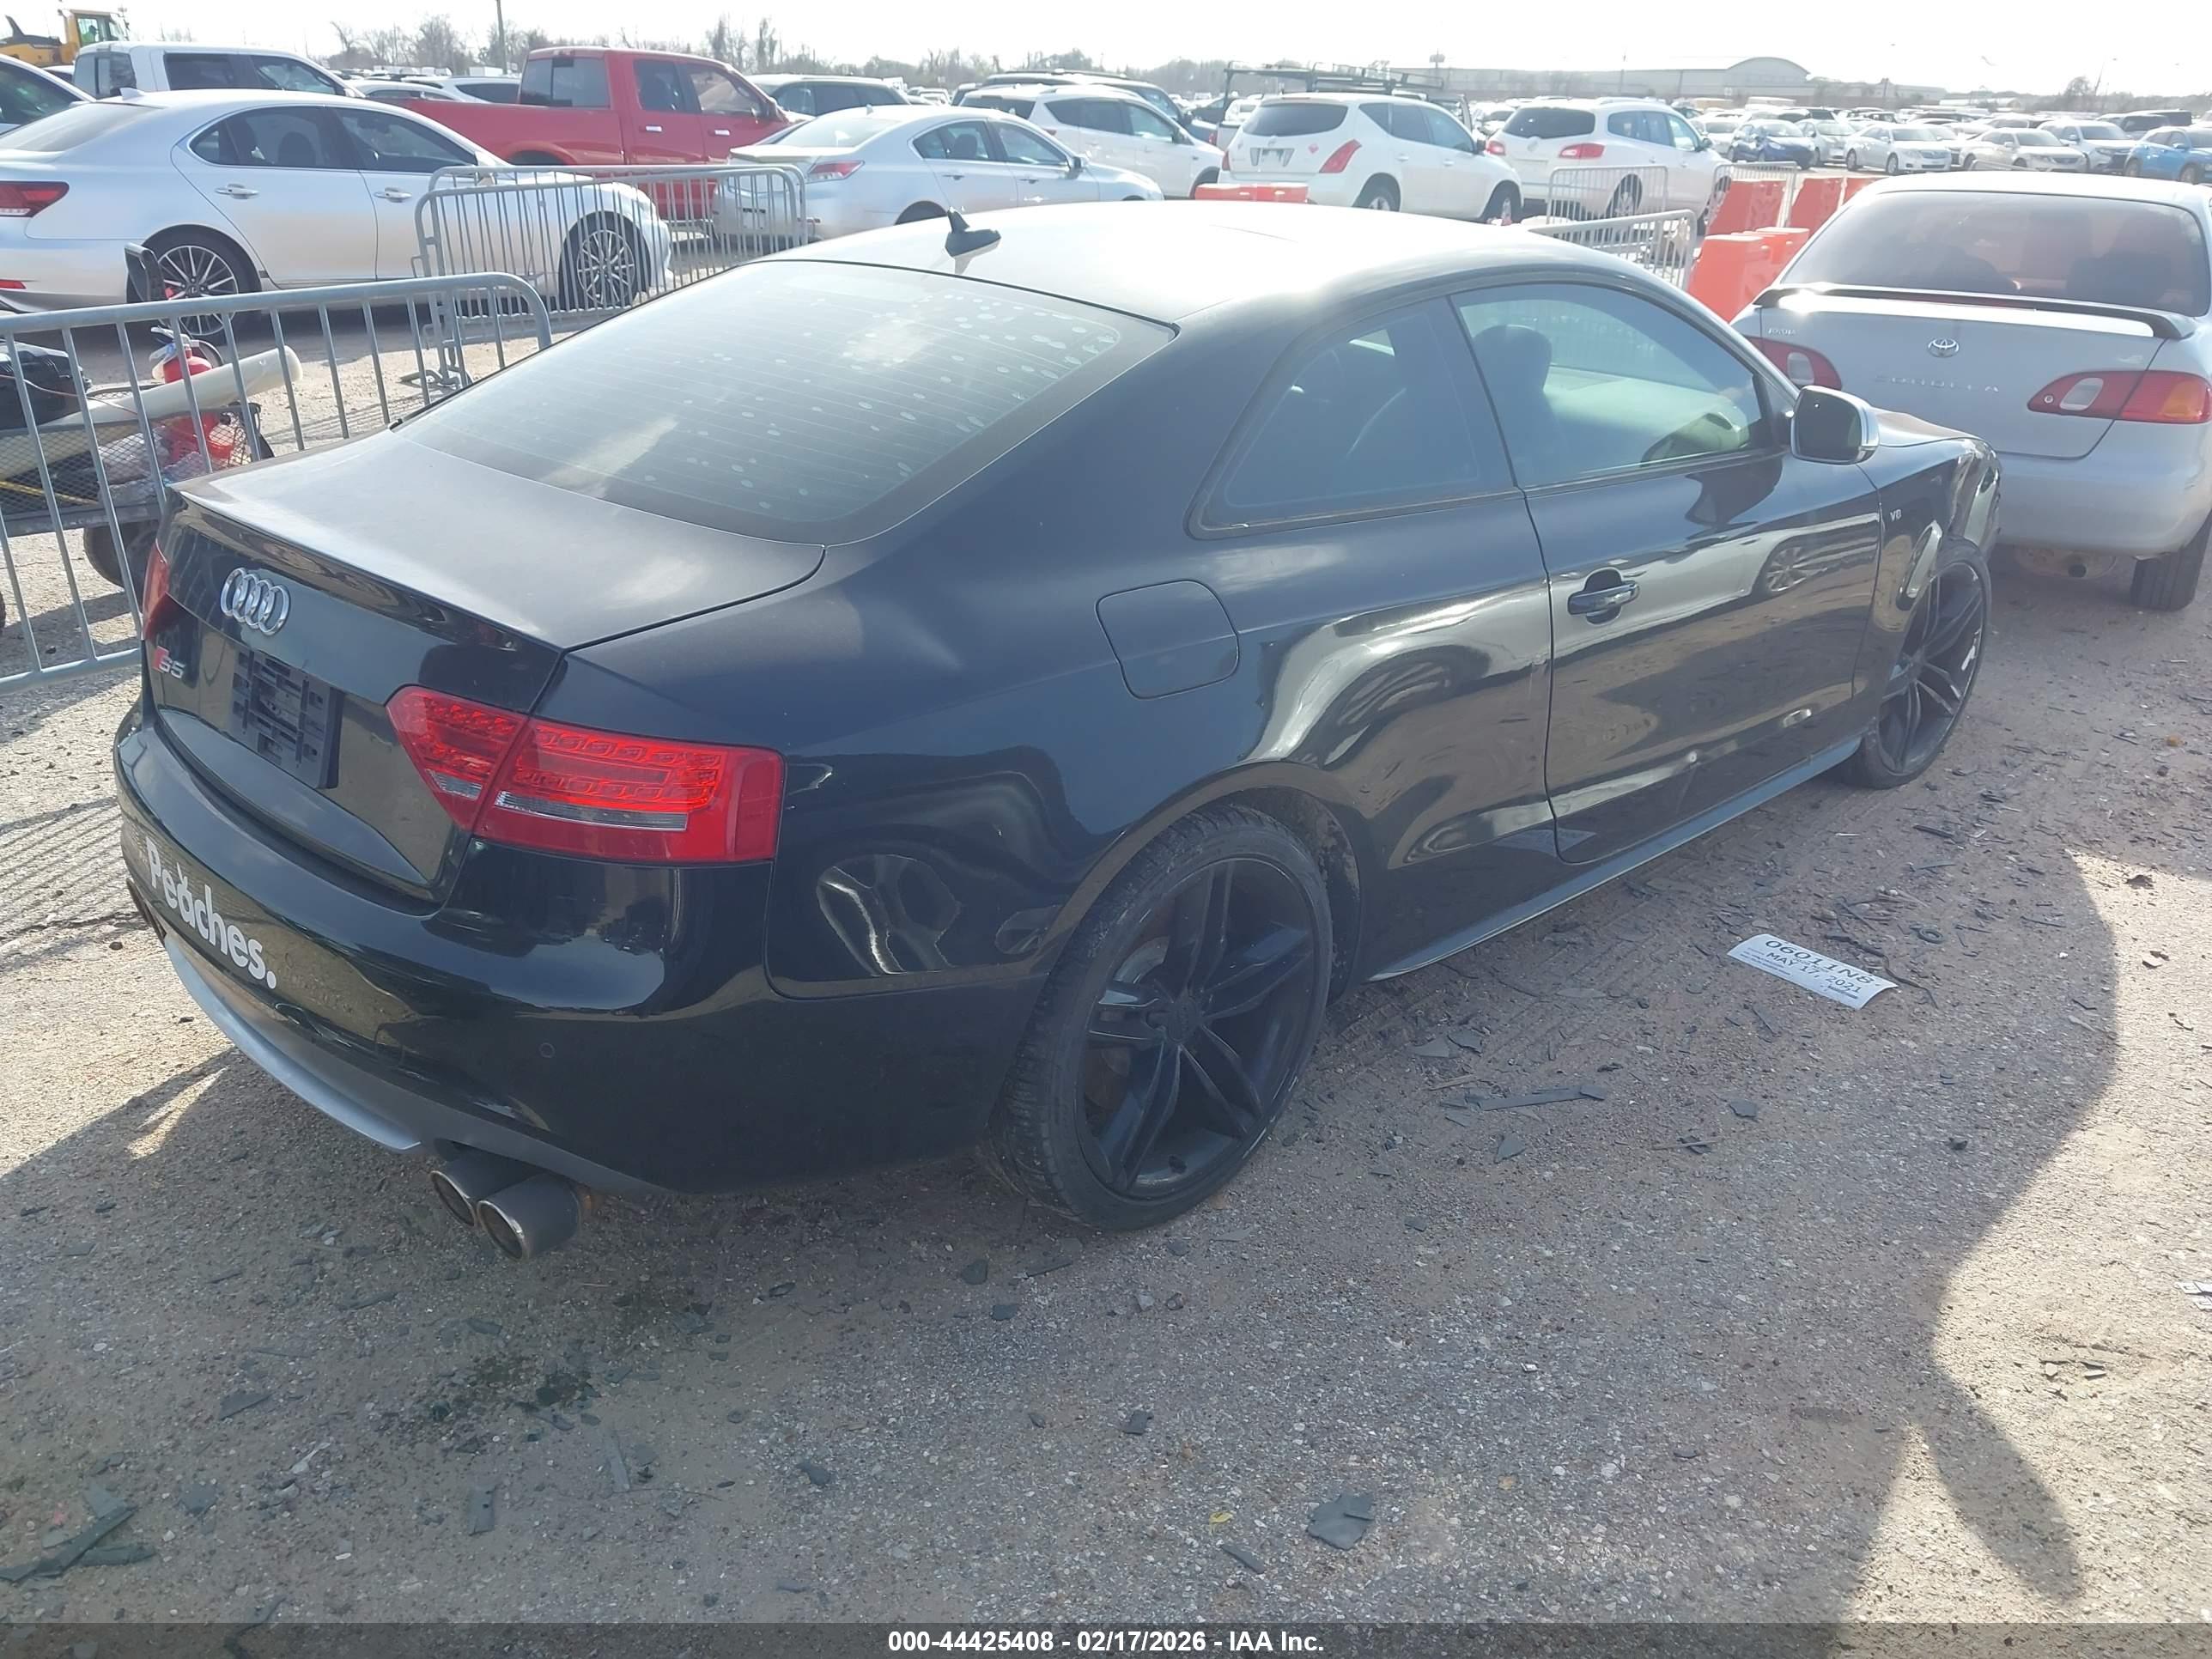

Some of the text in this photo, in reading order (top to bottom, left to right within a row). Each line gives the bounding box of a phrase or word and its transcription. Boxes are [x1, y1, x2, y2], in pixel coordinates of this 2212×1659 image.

[1889, 508, 1902, 521] V8
[157, 654, 186, 678] S5
[145, 836, 276, 988] Peaches.
[1766, 952, 1796, 967] MAY
[1826, 975, 1862, 994] 2021
